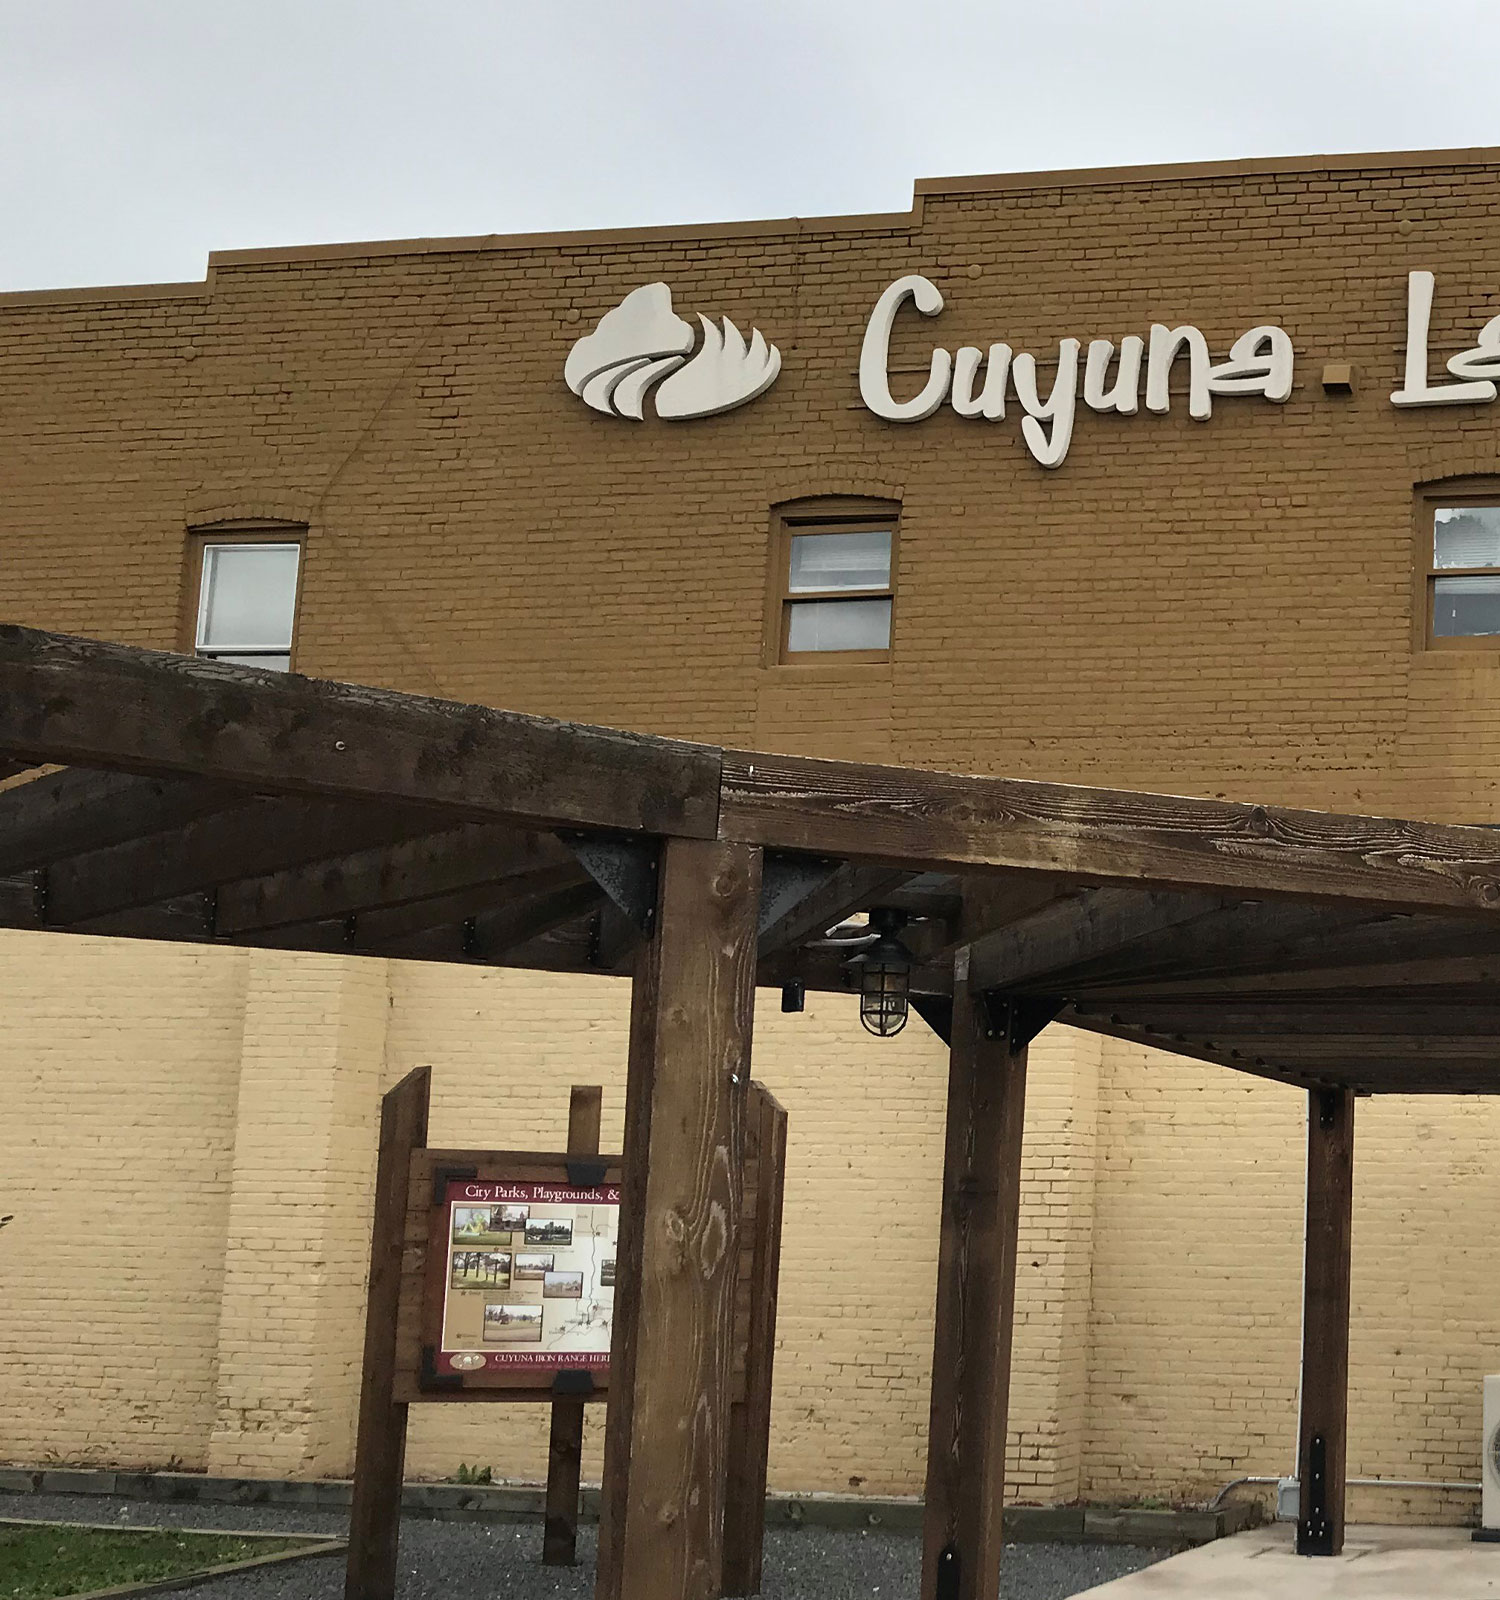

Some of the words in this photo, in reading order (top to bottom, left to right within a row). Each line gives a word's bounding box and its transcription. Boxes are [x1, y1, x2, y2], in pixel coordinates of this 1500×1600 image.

[859, 275, 1294, 469] Cuyuna
[465, 1185, 491, 1200] City
[495, 1186, 529, 1199] Parks,
[533, 1187, 603, 1202] Playgrounds,
[607, 1189, 619, 1200] &
[495, 1354, 533, 1362] CUYUNA
[535, 1354, 556, 1362] IRON
[557, 1354, 587, 1362] RANGE
